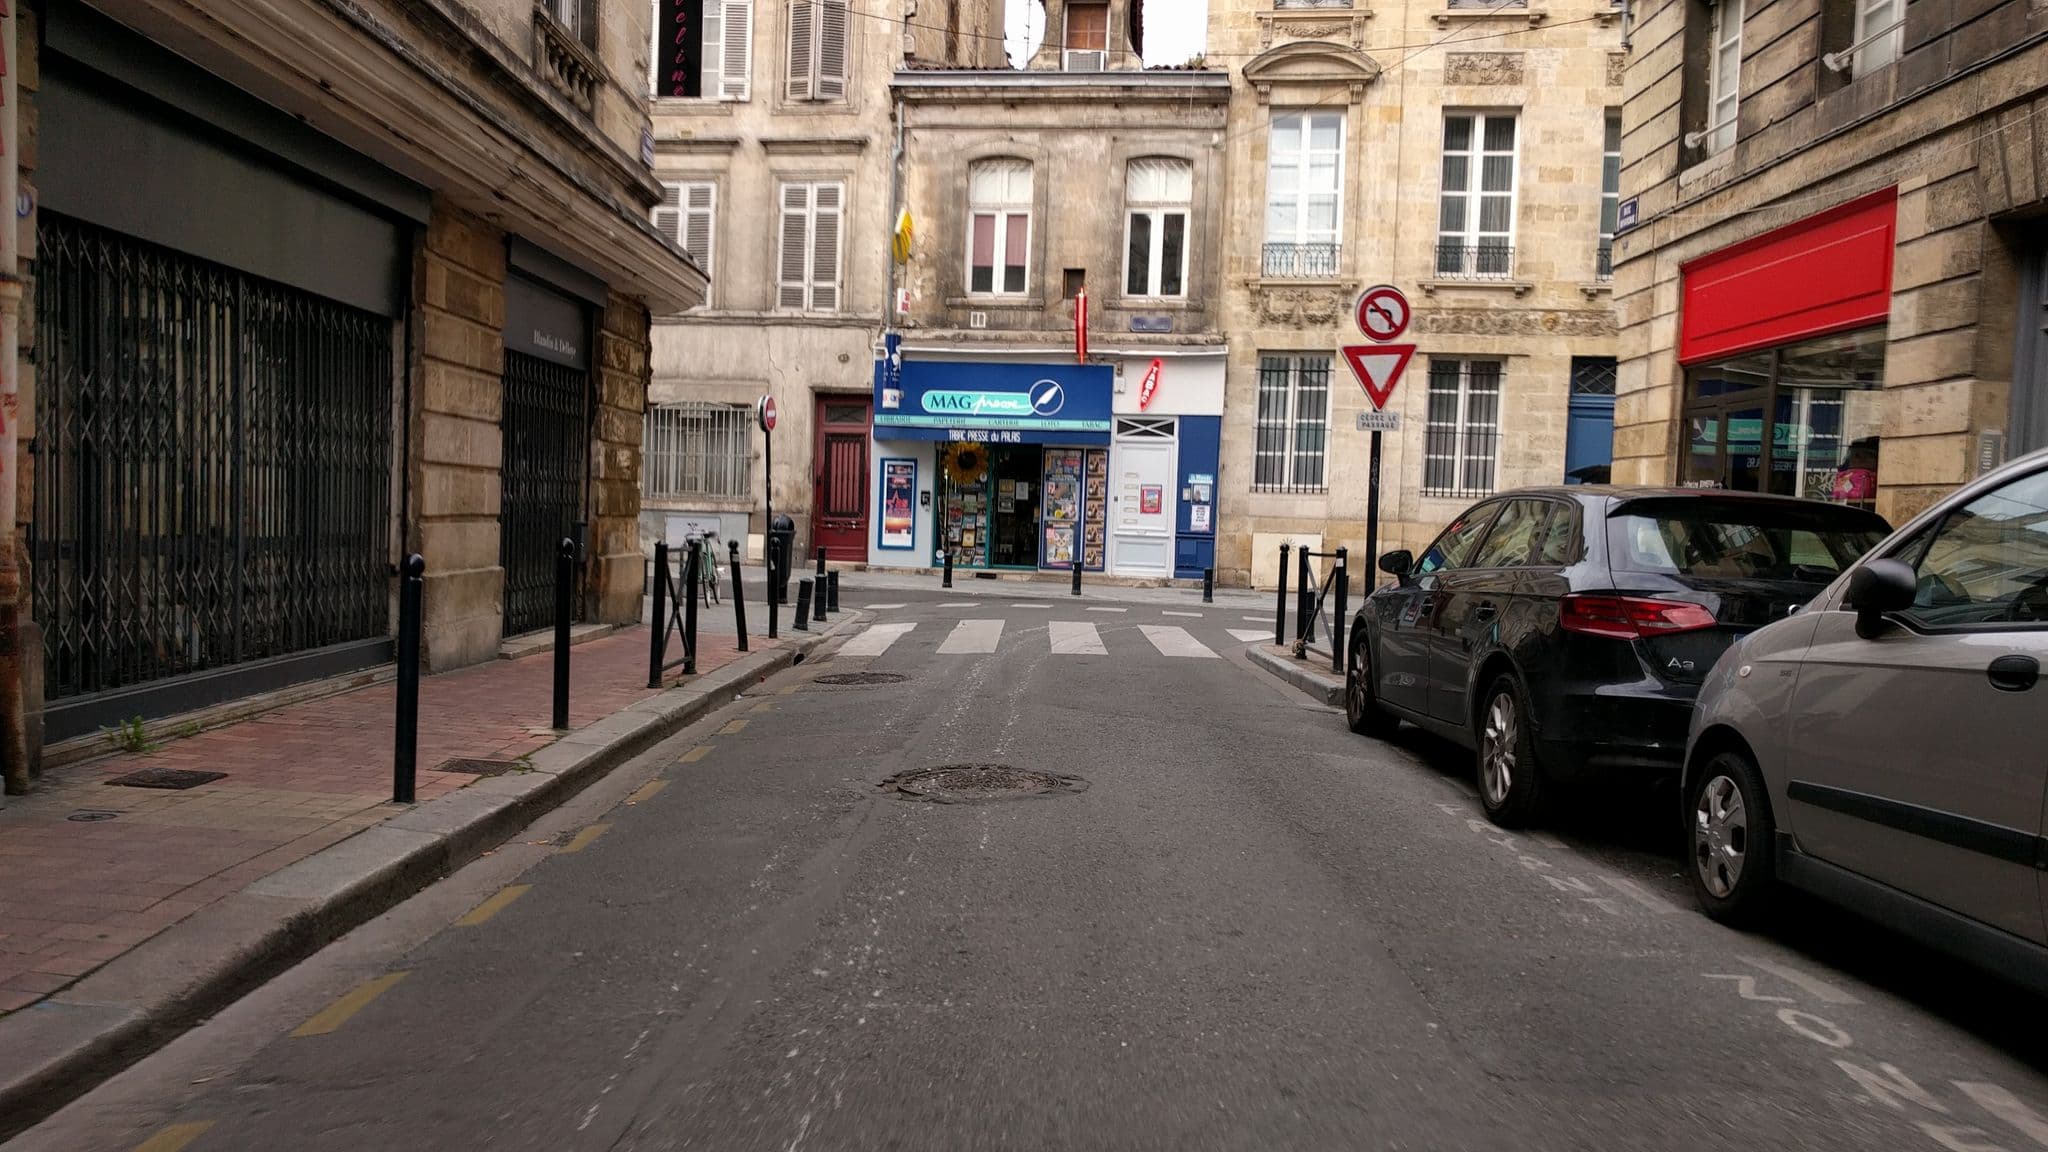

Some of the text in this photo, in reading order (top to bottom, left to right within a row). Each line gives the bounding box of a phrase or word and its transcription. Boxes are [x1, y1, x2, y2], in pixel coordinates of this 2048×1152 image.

[1141, 366, 1158, 403] TABAC
[930, 394, 971, 410] MAG
[949, 429, 1021, 443] TABAC PRESSE du PALAIS
[1667, 657, 1694, 670] A3
